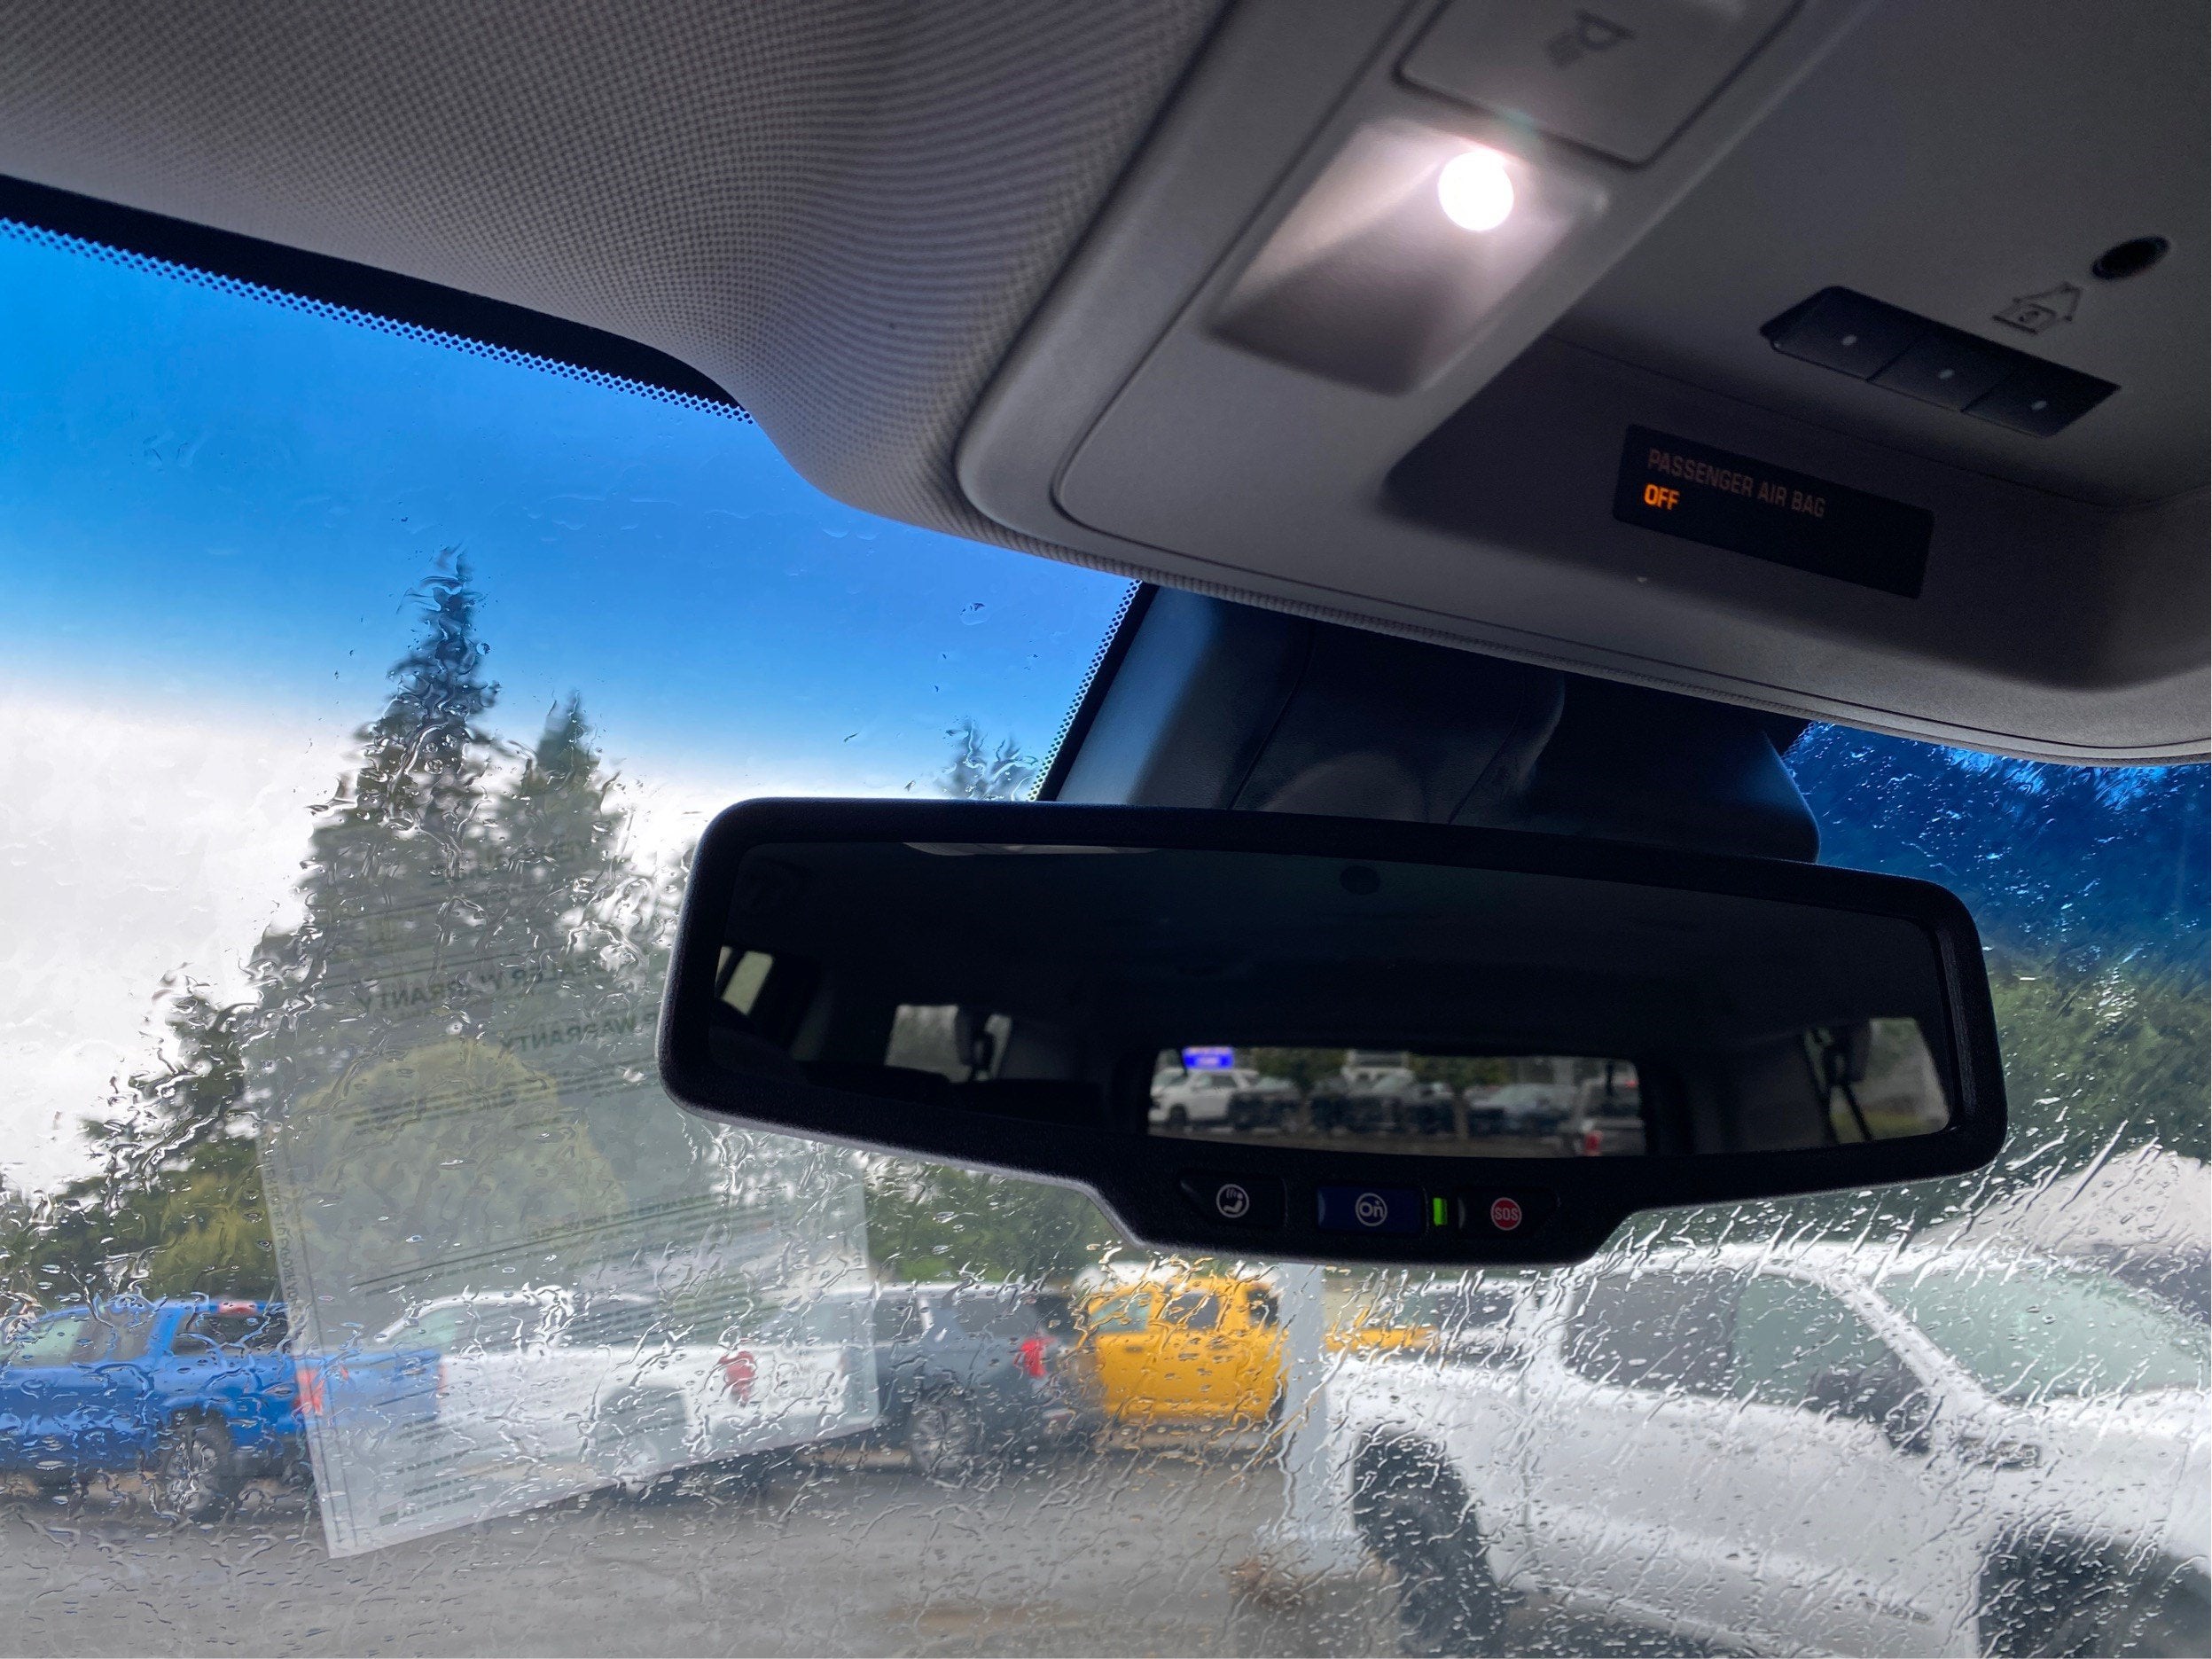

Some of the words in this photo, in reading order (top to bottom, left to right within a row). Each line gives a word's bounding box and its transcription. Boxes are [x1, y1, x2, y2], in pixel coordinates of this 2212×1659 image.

[1644, 483, 1681, 511] OFF
[1648, 448, 1754, 497] PASSENGER
[1757, 480, 1787, 507] AIR
[1791, 490, 1826, 518] BAG
[1494, 1206, 1519, 1222] SOS
